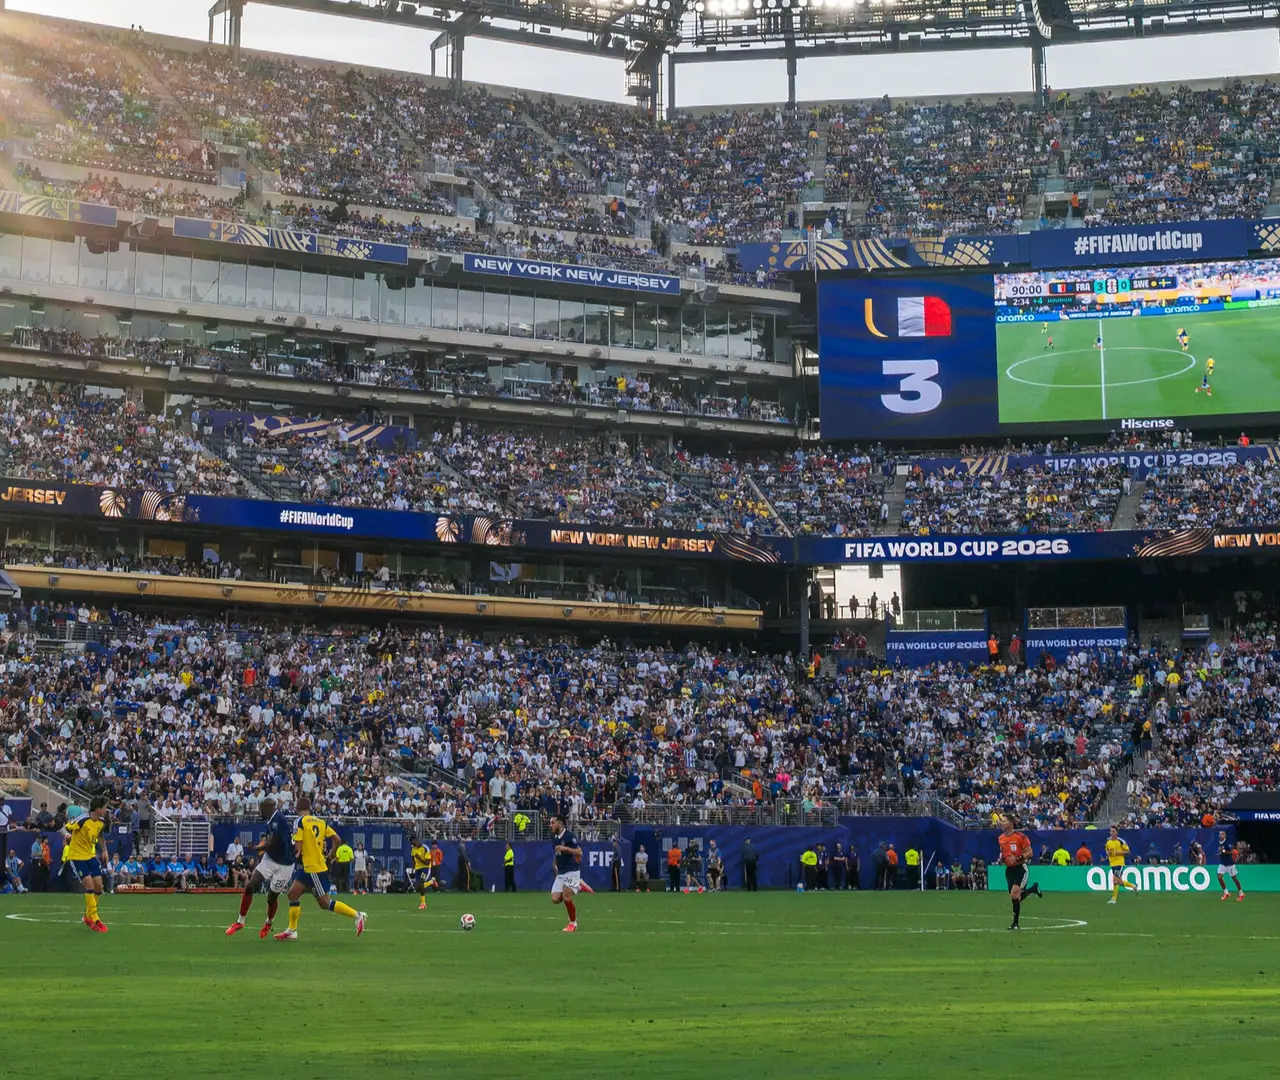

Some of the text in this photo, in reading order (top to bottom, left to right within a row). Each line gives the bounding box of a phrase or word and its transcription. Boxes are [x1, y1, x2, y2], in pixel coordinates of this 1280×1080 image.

[1074, 230, 1203, 255] #FIFAWorldCup
[474, 258, 670, 289] NEW YORK NEW JERSEY
[1011, 285, 1042, 296] 90:00
[1076, 278, 1149, 292] FRA 3 0 SWE
[1012, 298, 1030, 306] 2:34
[1164, 304, 1200, 314] aramco
[996, 314, 1035, 322] aramco
[881, 359, 942, 414] 3
[1121, 418, 1174, 428] Hisense
[1179, 451, 1237, 467] 2026
[0, 486, 67, 505] JERSEY
[280, 509, 354, 530] #FIFAWorldCup
[550, 529, 715, 553] NEW YORK NEW JERSEY
[845, 538, 1069, 558] FIFA WORLD CUP 2026
[1214, 534, 1251, 548] NEW
[886, 641, 987, 650] FIFA WORLD CUP 2026
[1026, 638, 1127, 647] FIFA WORLD CUP 2026
[589, 851, 624, 867] FIF
